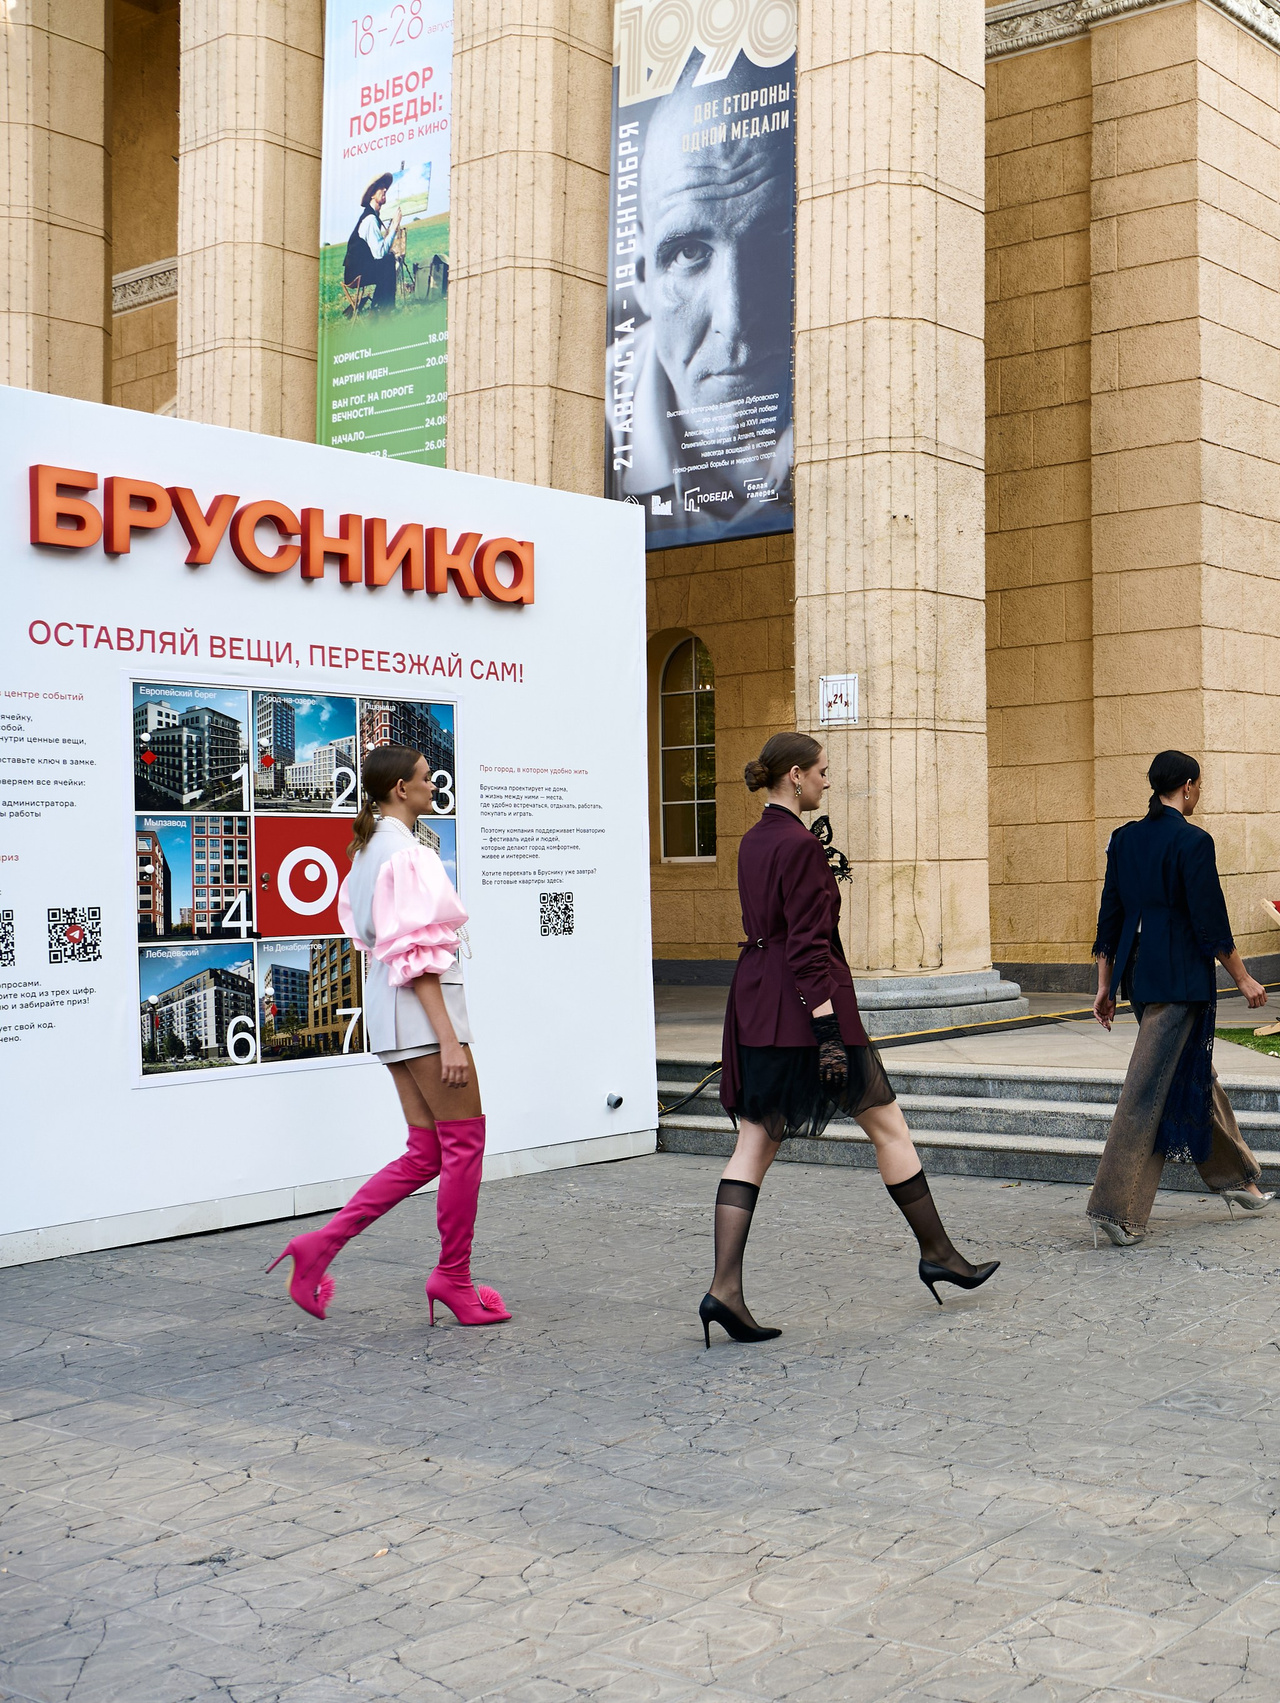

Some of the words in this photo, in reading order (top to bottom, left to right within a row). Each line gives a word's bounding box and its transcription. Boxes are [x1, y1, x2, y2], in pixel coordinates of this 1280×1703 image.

[619, 0, 797, 103] 1990
[360, 66, 433, 108] ВЫБОР
[350, 92, 443, 138] ПОБЕДЫ:
[694, 100, 719, 125] ДВЕ
[723, 82, 790, 115] СТОРОНЫ
[343, 132, 405, 159] ИСКУССТВО
[408, 128, 415, 140] В
[417, 119, 448, 137] КИНО
[682, 123, 727, 153] ОДНОЙ
[731, 109, 790, 141] МЕДАЛИ
[616, 121, 639, 255] СЕНТЯБРЯ
[615, 262, 636, 290] 19
[333, 348, 372, 365] ХОРИСТЫ
[332, 372, 364, 387] МАРТИН
[366, 367, 388, 381] ИДЕН
[614, 317, 635, 433] АВГУСТА
[332, 398, 348, 410] ВАН
[350, 394, 366, 407] ГОГ.
[368, 392, 380, 403] НА
[381, 384, 414, 400] ПОРОГЕ
[332, 406, 374, 423] ВЕЧНОСТИ
[332, 430, 365, 445] НАЧАЛО
[614, 444, 633, 471] 21
[697, 490, 734, 504] ПОБЕДА
[747, 481, 768, 491] белая
[747, 488, 775, 499] галерея
[28, 619, 199, 657] ОСТАВЛЯЙ
[209, 635, 300, 669] ВЕЩИ,
[309, 644, 463, 679] ПЕРЕЕЗЖАЙ
[469, 659, 524, 684] САМ!
[4, 690, 40, 699] центре
[42, 692, 84, 701] событий
[140, 686, 193, 697] Европейский
[194, 690, 217, 699] берег
[231, 763, 249, 811] 1
[330, 766, 357, 813] 2
[431, 770, 454, 815] 3
[144, 818, 187, 828] Мылзавод
[221, 890, 253, 939] 4
[145, 948, 199, 959] Лебедевский
[263, 944, 273, 952] На
[275, 943, 323, 953] Декабристов
[20, 1000, 64, 1009] забирайте
[66, 997, 90, 1006] приз!
[72, 987, 96, 995] цифр.
[226, 1016, 256, 1064] 6
[336, 1008, 362, 1054] 7
